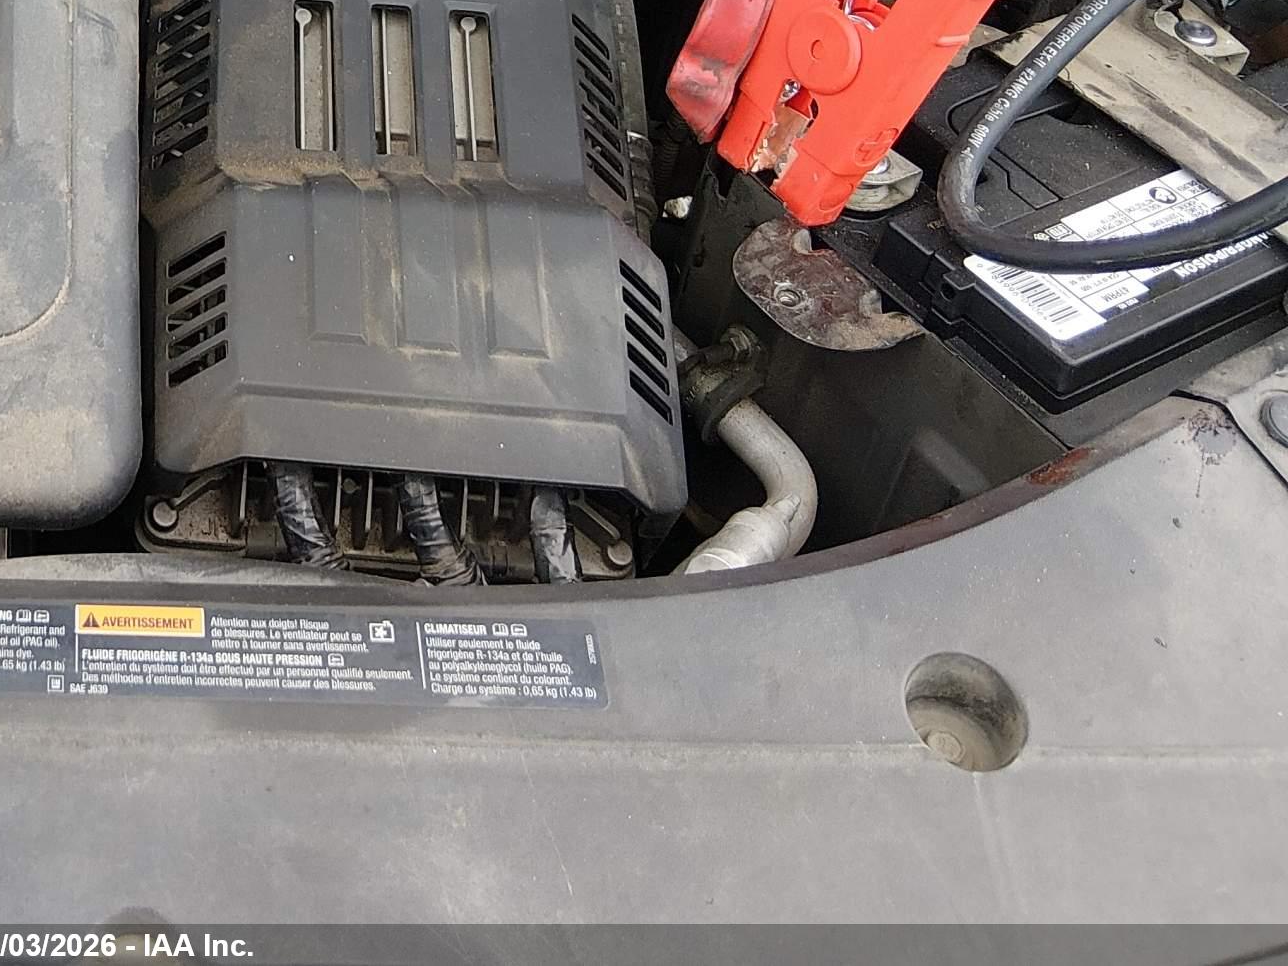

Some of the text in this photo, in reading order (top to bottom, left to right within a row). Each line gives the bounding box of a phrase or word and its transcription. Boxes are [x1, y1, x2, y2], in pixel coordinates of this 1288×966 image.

[102, 616, 194, 629] AVERTISSEMENT
[210, 616, 248, 628] Attention
[251, 619, 266, 628] aux
[300, 619, 330, 631] Risque
[424, 623, 487, 635] CLIMATISEUR
[0, 624, 47, 636] Refrigerant
[49, 626, 66, 635] and
[211, 629, 362, 643] de blessures. Le ventilateur peut se
[10, 636, 20, 646] oil
[22, 636, 42, 648] (PAG
[44, 637, 60, 649] oil).
[211, 639, 240, 650] mettre
[250, 640, 281, 650] tourner
[283, 642, 303, 651] sans
[305, 642, 369, 653] avertissement.
[425, 637, 541, 650] Utiliser seulement le fluide
[16, 649, 34, 660] dye.
[82, 648, 323, 667] FLUIDE FRIGORIGÈNE R-134a SOUS HAUTE PRESSION
[427, 649, 563, 662] frigorigène R-134a et de l'huile
[16, 660, 27, 672] kg
[29, 660, 52, 672] (1.43
[54, 660, 66, 672] lb)
[82, 660, 128, 672] L'entretien
[129, 662, 141, 672] du
[180, 663, 197, 673] doit
[219, 665, 254, 676] effectué
[256, 667, 271, 678] par
[273, 667, 285, 676] un
[287, 668, 329, 679] personnel
[331, 668, 363, 680] qualifié
[429, 662, 440, 670] au
[523, 663, 548, 673] (huile
[550, 664, 574, 674] PAG).
[82, 672, 377, 691] Des méthodes d'entretien incorrectes peuvent causer des blessures.
[430, 672, 441, 681] Le
[482, 674, 518, 684] contient
[520, 674, 532, 684] du
[70, 683, 108, 694] SAE J639
[431, 683, 464, 696] Charge
[465, 684, 477, 694] du
[523, 686, 544, 697] 0,65
[546, 687, 558, 699] kg
[585, 688, 597, 699] lb)
